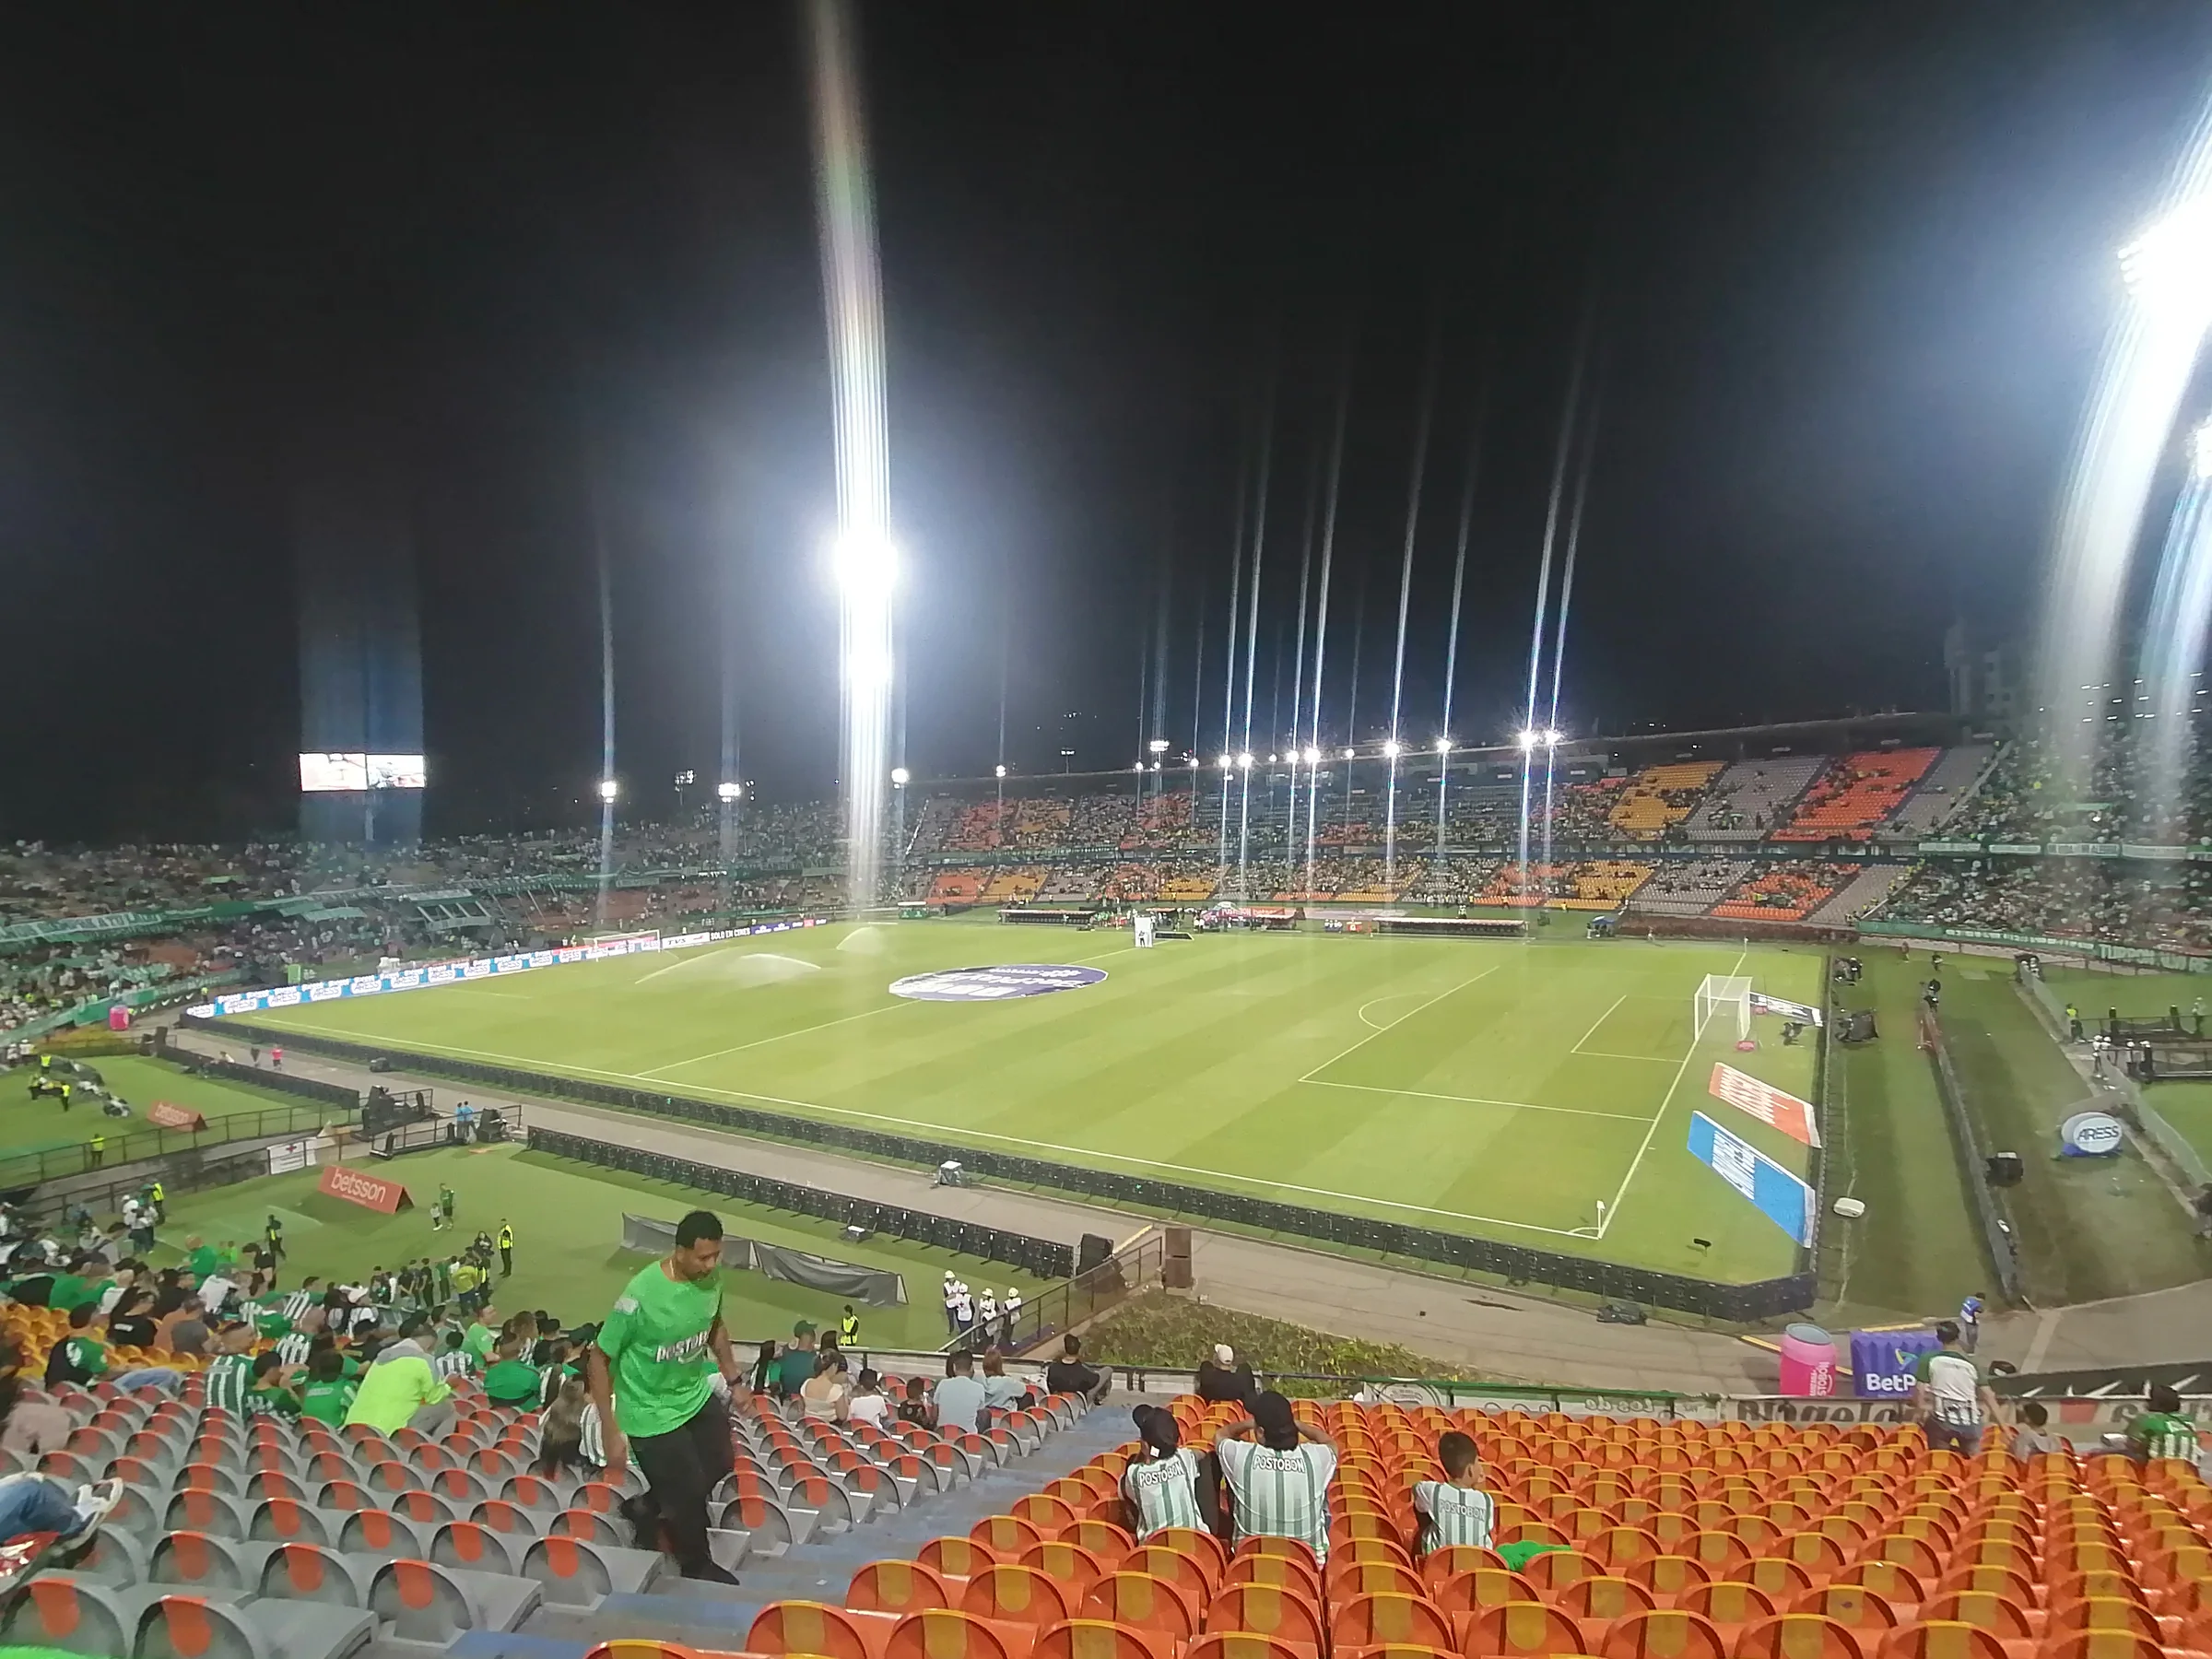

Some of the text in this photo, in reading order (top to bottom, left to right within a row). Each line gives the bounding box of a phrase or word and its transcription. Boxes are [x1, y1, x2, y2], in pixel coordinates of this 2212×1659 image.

[2077, 1125, 2120, 1141] ARESS
[331, 1168, 386, 1204] betsson
[656, 1330, 710, 1363] POSTOB
[1816, 1361, 1830, 1397] STOBÓN
[1866, 1373, 1917, 1392] BetP
